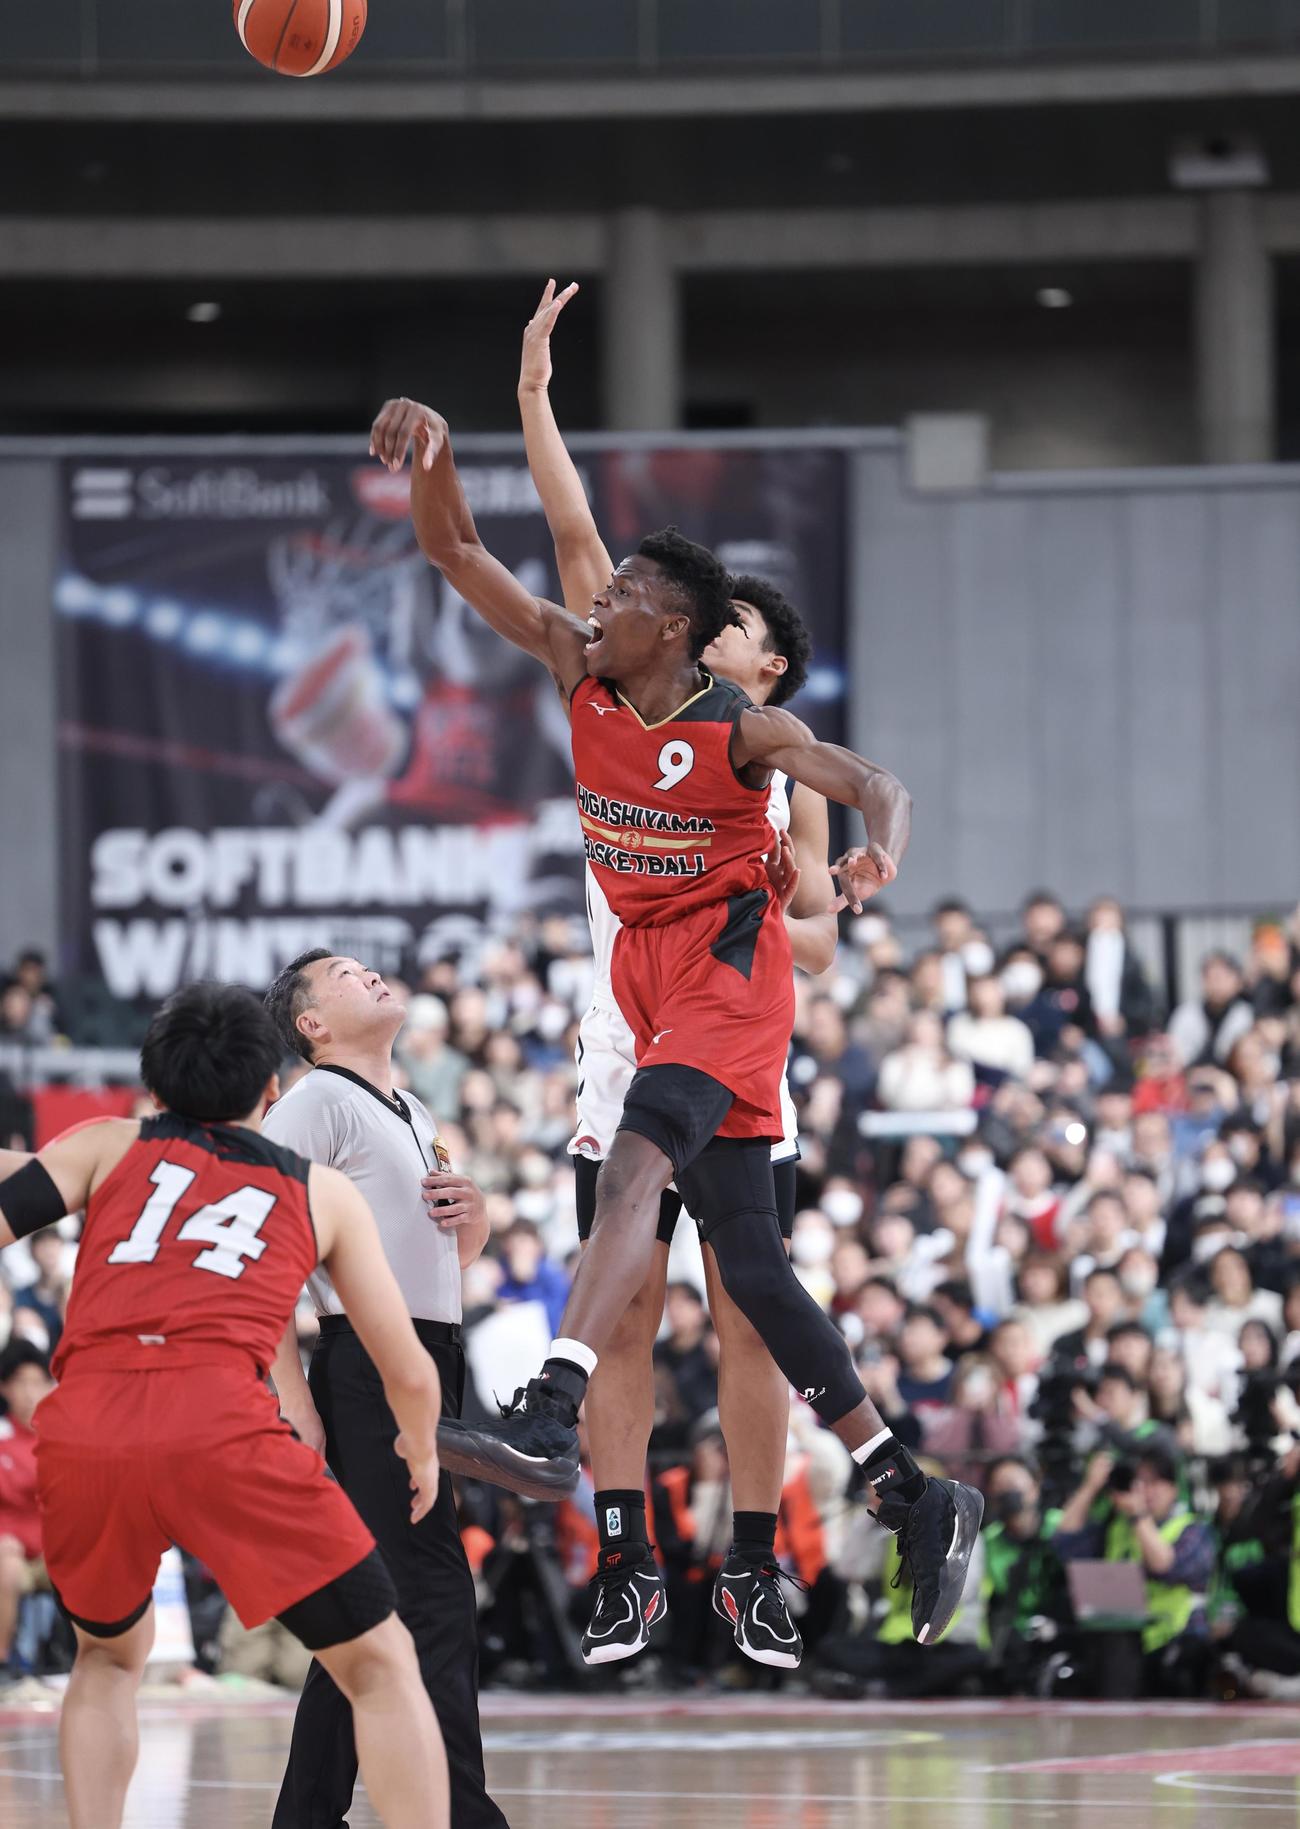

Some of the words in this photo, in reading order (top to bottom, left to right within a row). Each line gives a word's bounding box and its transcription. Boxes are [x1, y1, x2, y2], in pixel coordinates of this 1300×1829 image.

[652, 738, 695, 792] 9
[577, 782, 716, 833] HIGASHIYAMA
[583, 831, 710, 877] BASKETBALL
[107, 1160, 279, 1281] 14
